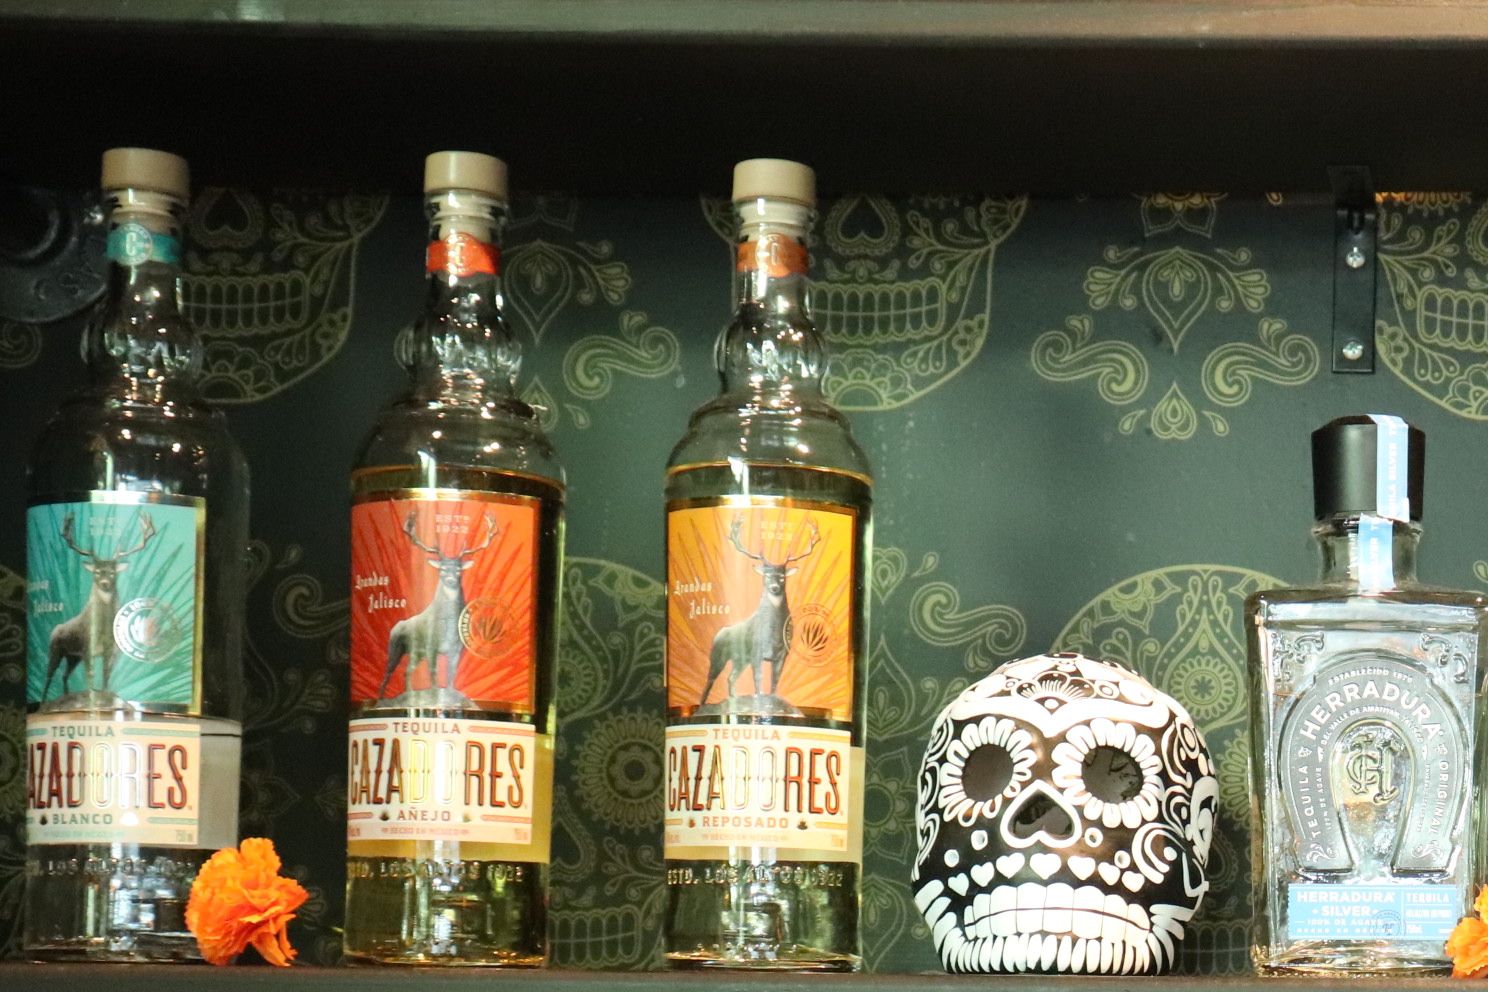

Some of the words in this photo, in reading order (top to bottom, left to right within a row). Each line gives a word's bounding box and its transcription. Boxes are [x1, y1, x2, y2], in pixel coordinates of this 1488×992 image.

[368, 592, 407, 613] Jalisco
[689, 598, 731, 619] Jalisco
[1328, 668, 1389, 686] ESTABLECIDO
[1300, 679, 1442, 741] HERRADURA
[1349, 707, 1361, 717] DE
[52, 725, 115, 740] TEQUILA
[392, 721, 461, 736] TEQUILA
[712, 728, 781, 741] TEQUILA
[351, 738, 525, 809] CAZADORES
[668, 744, 842, 815] CAZADORES
[1298, 765, 1322, 839] TEQUILA
[1427, 761, 1450, 836] ORIGINAL
[52, 813, 113, 825] BLANCO
[397, 807, 451, 821] AÑEJO
[702, 816, 789, 829] REPOSADO
[1296, 891, 1395, 903] HERRADURA
[1406, 892, 1450, 903] TEQUILA
[1321, 905, 1374, 917] SILVER
